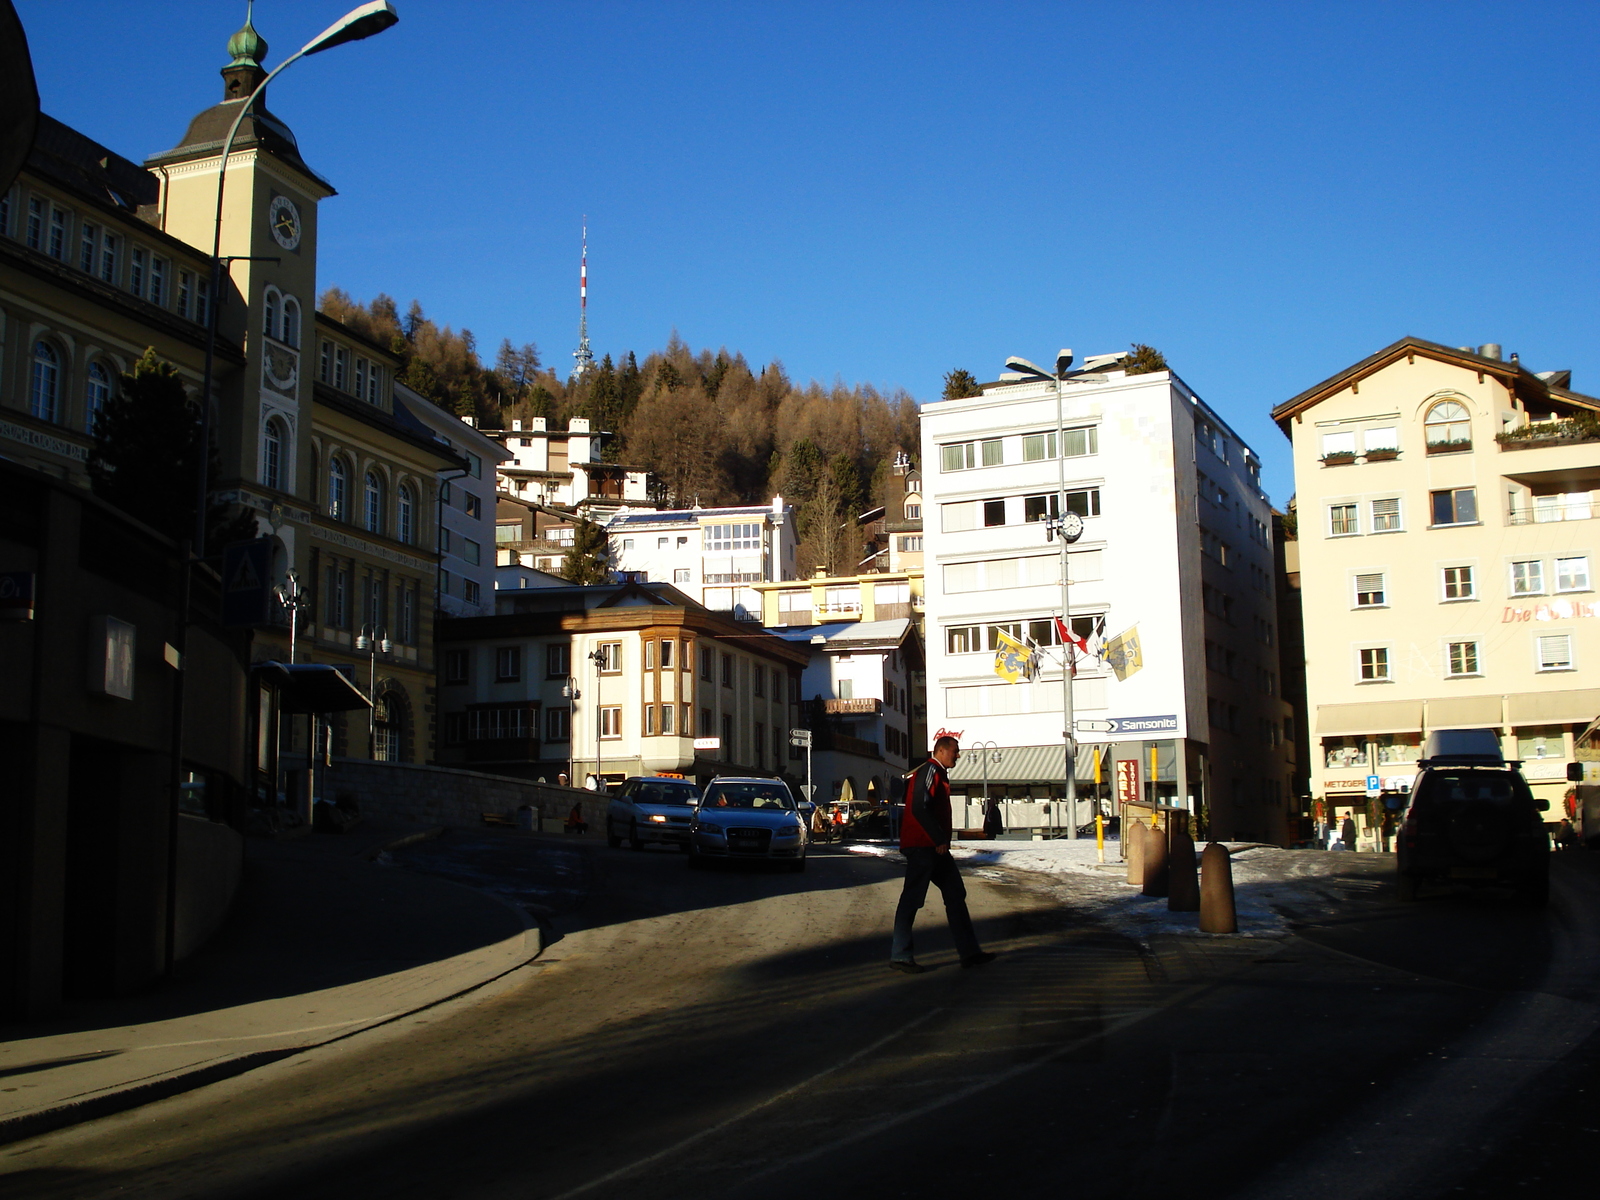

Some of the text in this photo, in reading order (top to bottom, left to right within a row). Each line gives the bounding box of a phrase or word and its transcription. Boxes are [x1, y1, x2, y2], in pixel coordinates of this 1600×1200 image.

[1122, 718, 1177, 730] Samsonite
[1117, 761, 1129, 801] KAEL
[1324, 780, 1367, 788] METZGERE
[1369, 777, 1378, 789] P
